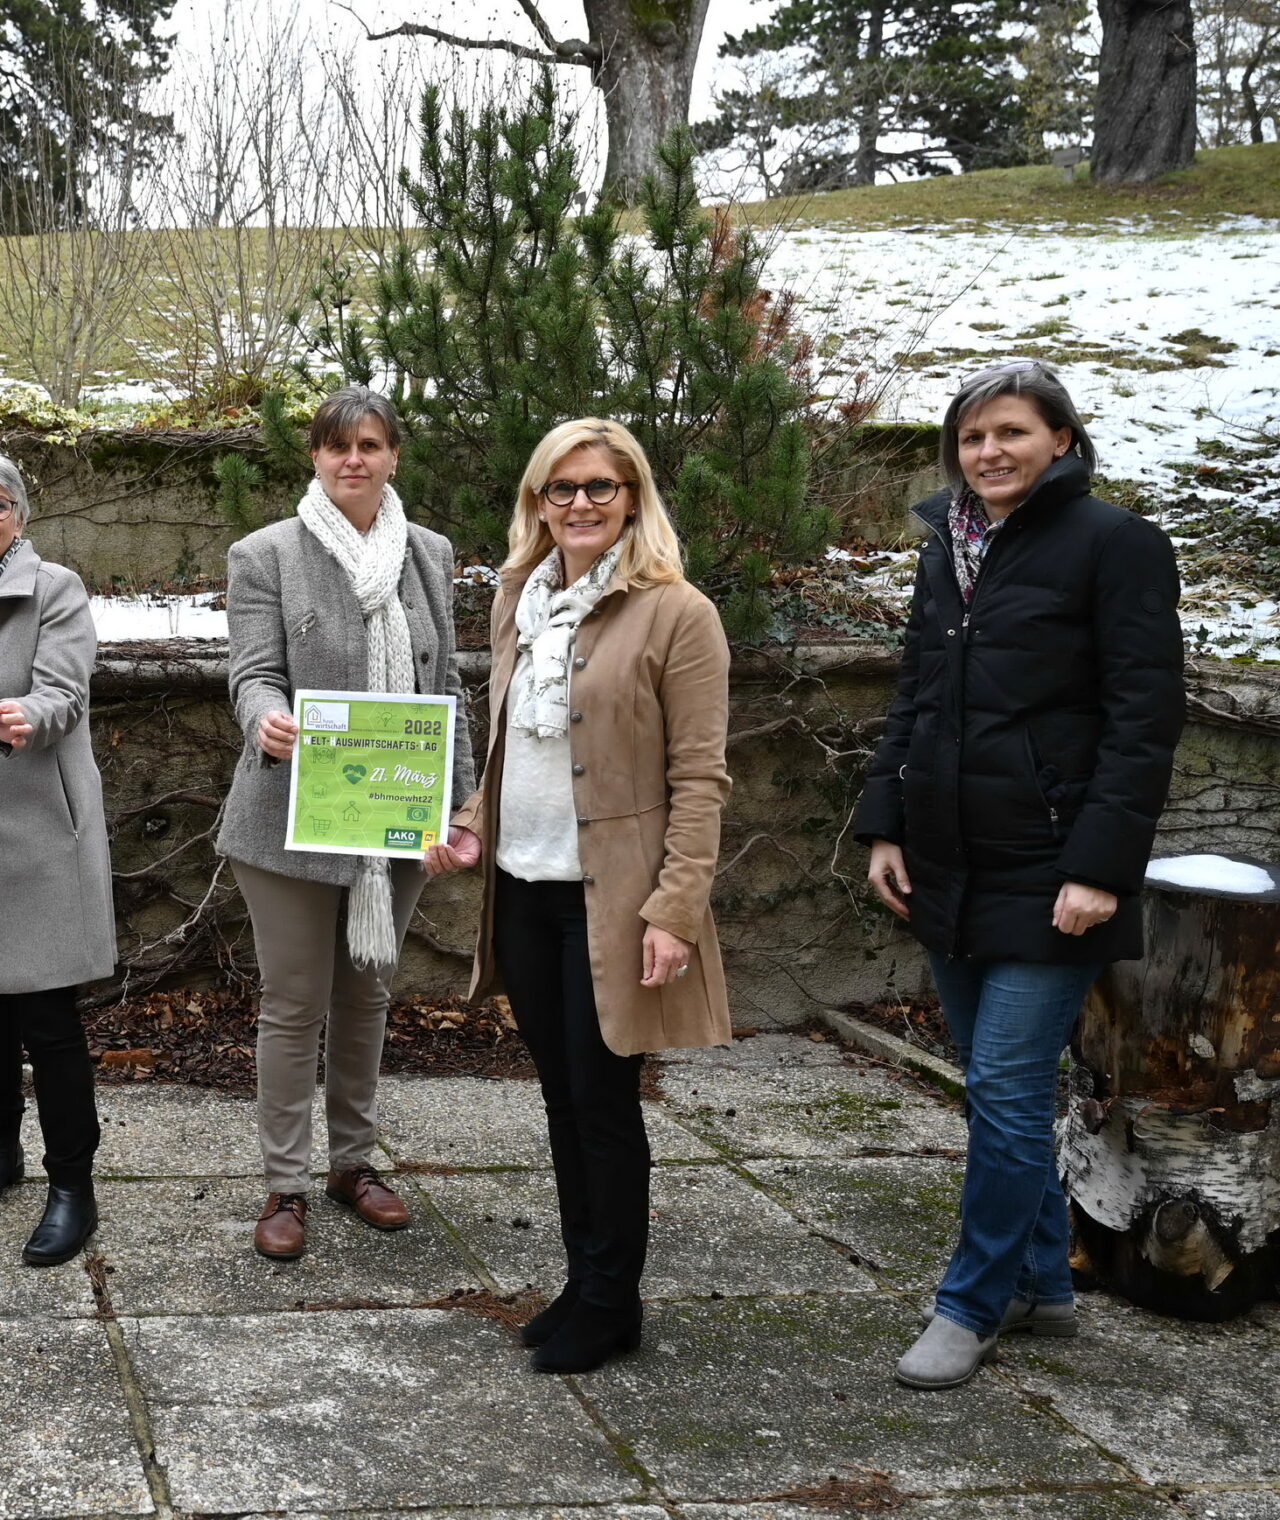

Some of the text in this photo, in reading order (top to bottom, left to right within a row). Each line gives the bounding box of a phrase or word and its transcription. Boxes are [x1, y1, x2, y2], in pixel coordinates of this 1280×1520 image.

[315, 722, 347, 730] wirtschaft
[404, 719, 442, 736] 2022
[369, 764, 438, 788] 21. März
[368, 792, 433, 804] #bhmoewht22
[388, 830, 416, 841] LAKO
